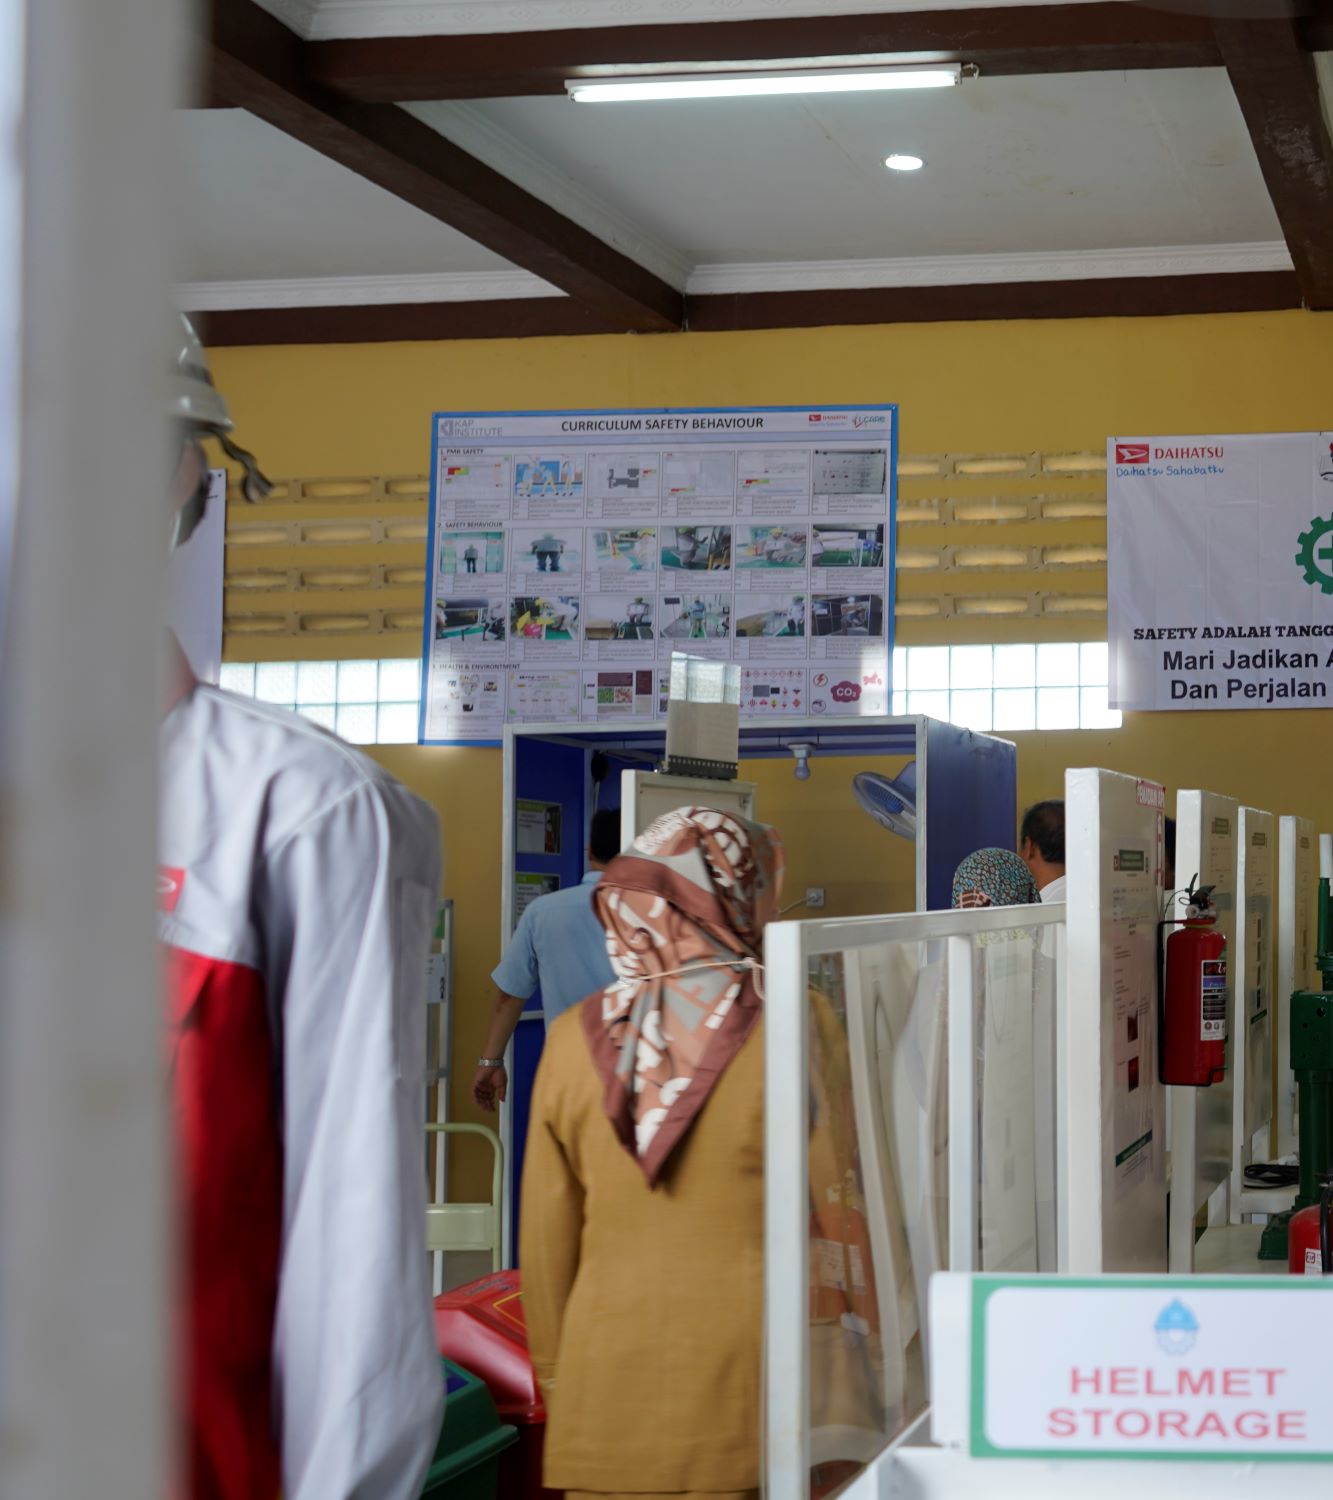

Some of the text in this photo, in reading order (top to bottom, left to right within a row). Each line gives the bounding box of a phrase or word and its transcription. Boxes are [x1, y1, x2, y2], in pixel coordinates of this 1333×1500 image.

[561, 417, 764, 432] CURRICULUM SAFETY BEHAVIOUR
[1155, 447, 1224, 460] DAIHATSU
[1116, 466, 1224, 477] Daihatsu Sahabatku
[1133, 627, 1198, 640] SAFETY
[1201, 626, 1271, 639] ADALAH
[1163, 650, 1214, 670] Mari
[1222, 648, 1318, 669] Jadikan
[1171, 679, 1218, 699] Dan
[1227, 677, 1326, 703] Perjalan
[1069, 1367, 1286, 1397] HELMET
[1046, 1408, 1308, 1440] STORAGE
